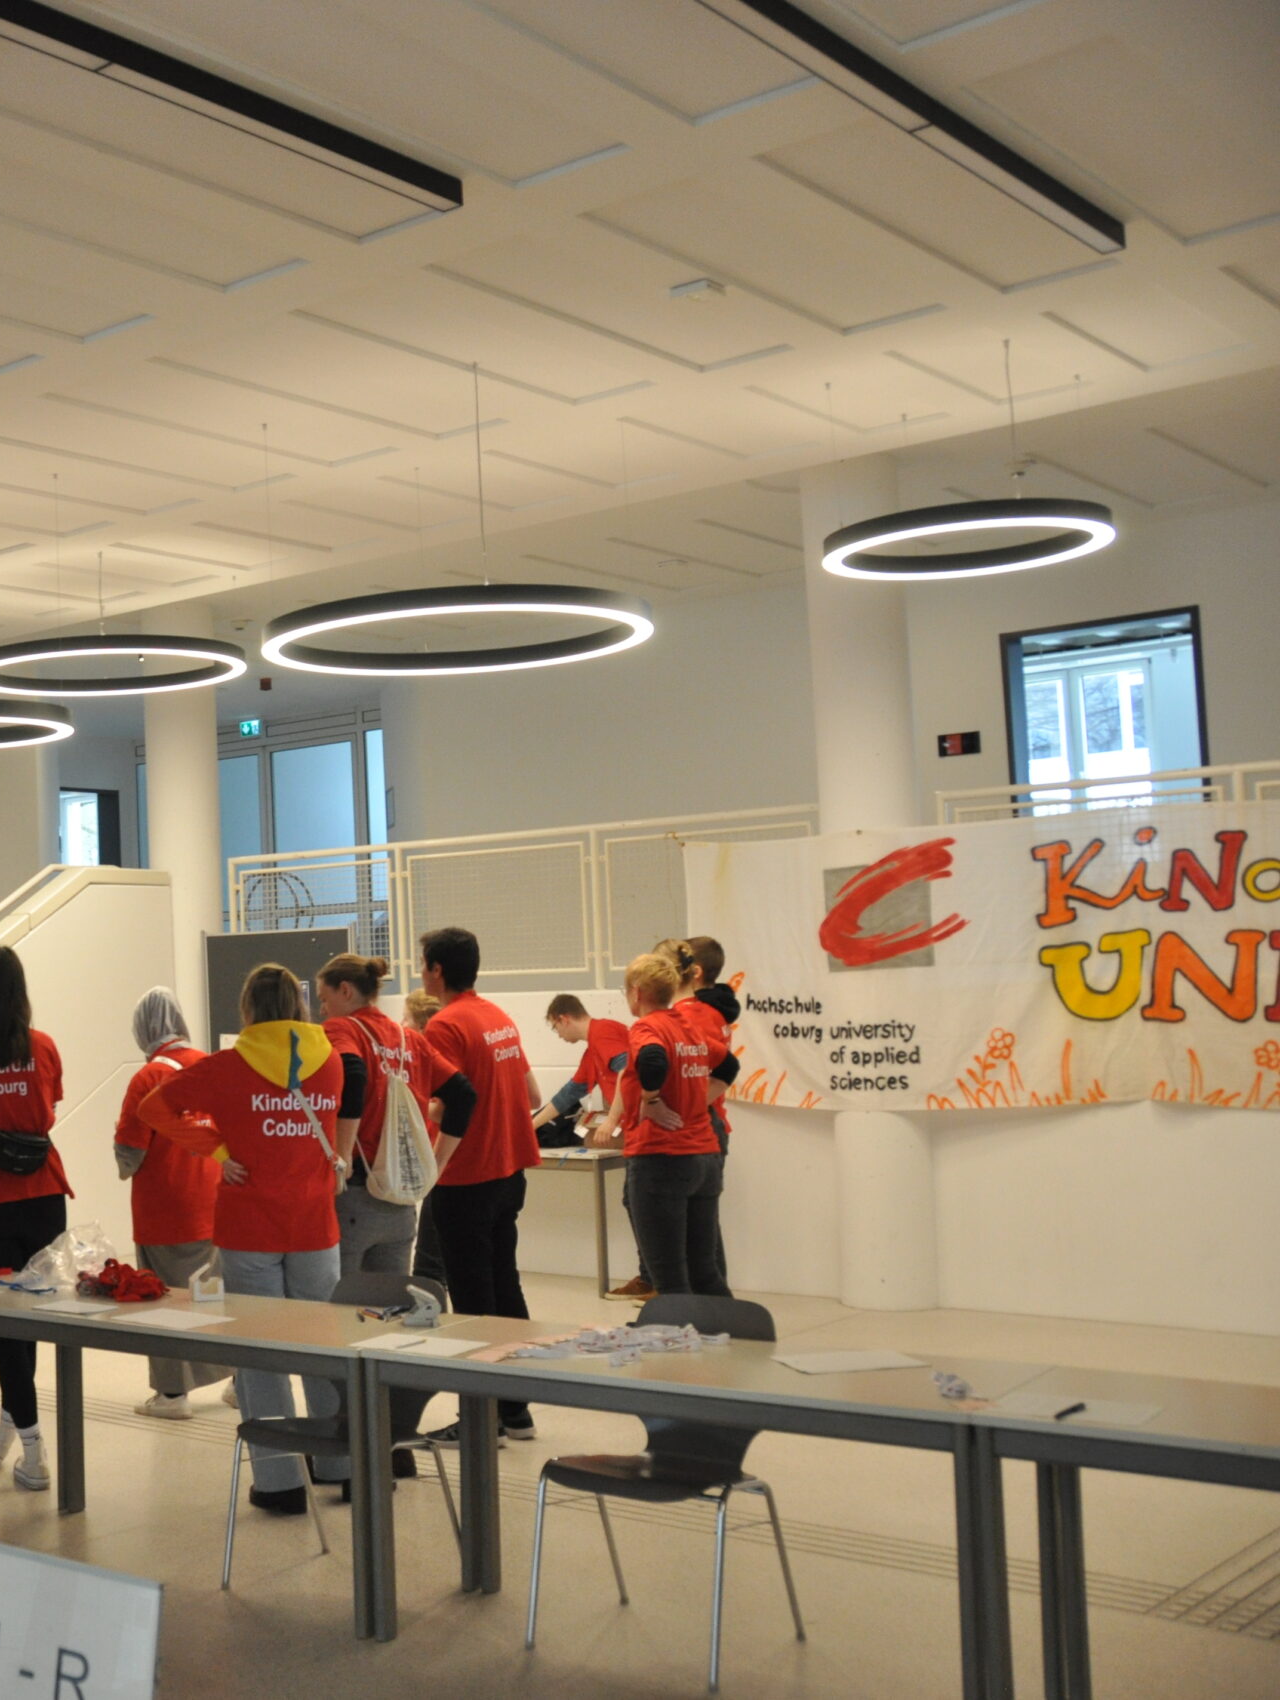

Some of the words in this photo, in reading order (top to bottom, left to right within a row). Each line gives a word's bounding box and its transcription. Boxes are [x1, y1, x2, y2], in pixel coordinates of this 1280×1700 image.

[746, 993, 822, 1014] hochschule
[773, 1022, 822, 1043] coburg
[830, 1020, 915, 1042] university
[830, 1046, 846, 1063] of
[851, 1047, 921, 1067] applied
[830, 1072, 909, 1090] sciences
[262, 1118, 322, 1139] Cobur
